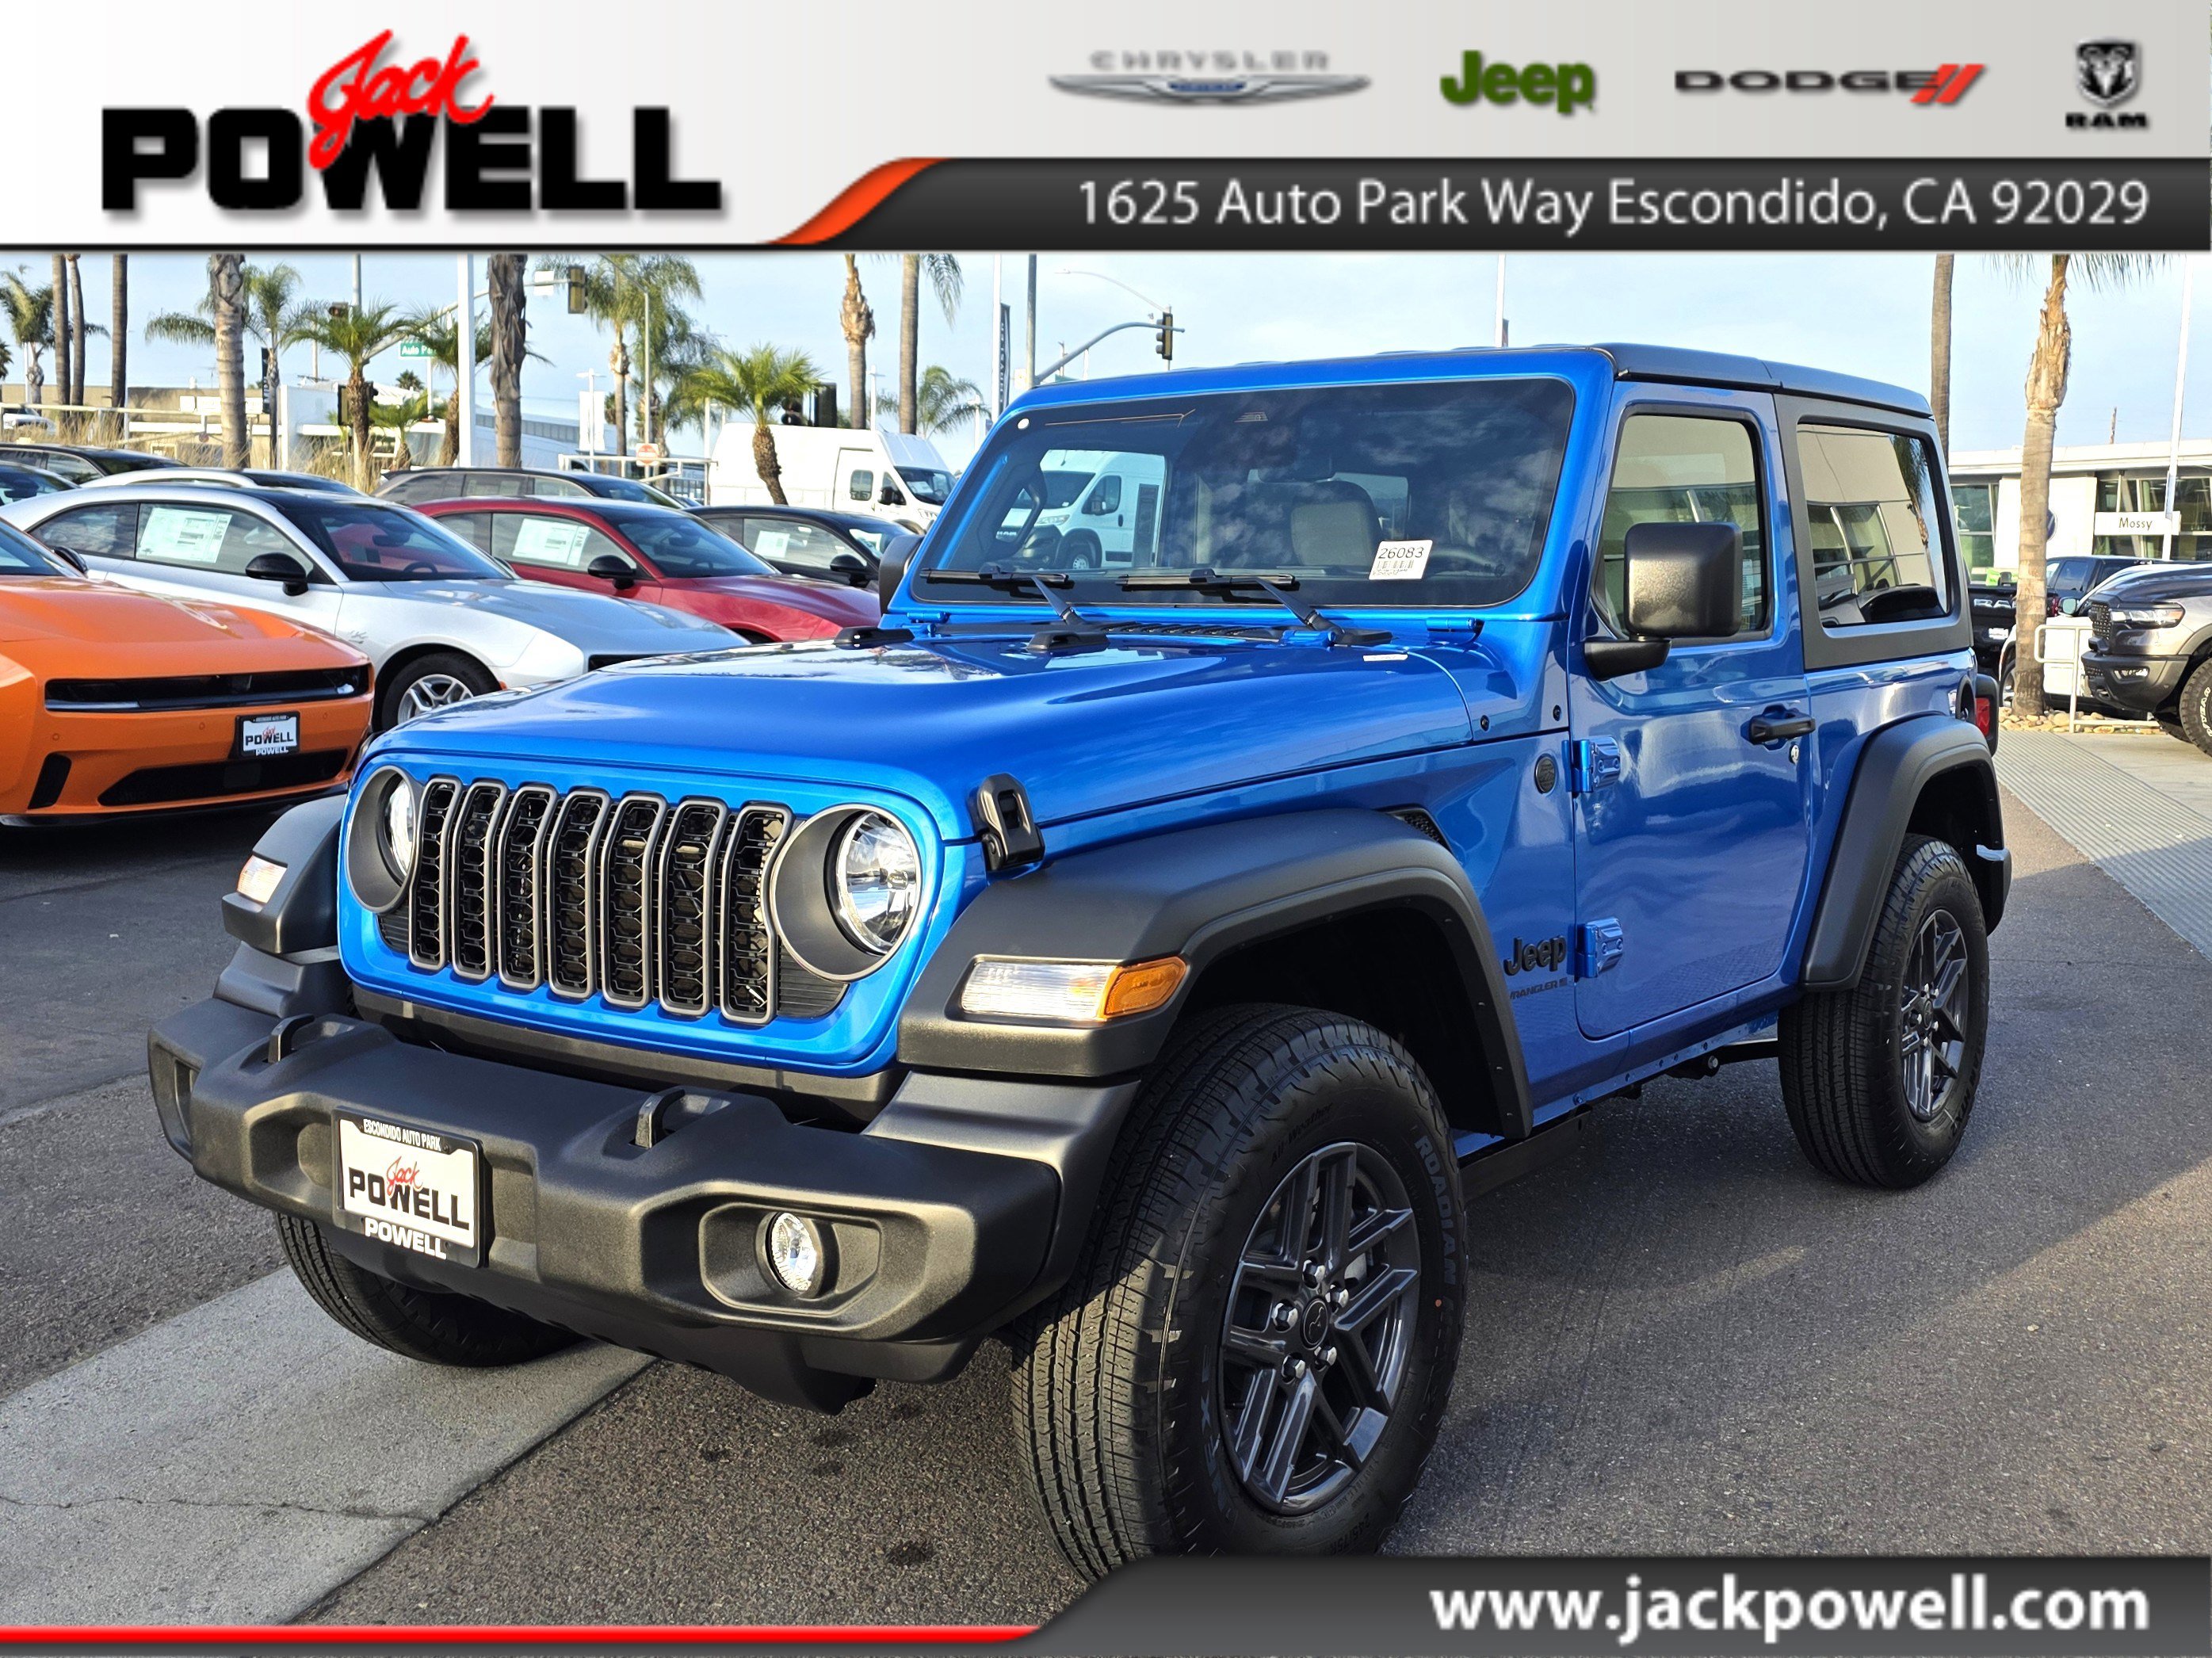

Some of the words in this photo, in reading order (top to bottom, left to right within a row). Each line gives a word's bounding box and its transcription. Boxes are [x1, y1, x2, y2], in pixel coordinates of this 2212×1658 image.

[402, 346, 420, 355] Auto
[2118, 518, 2153, 530] Mossy
[1378, 547, 1424, 559] 26083
[1973, 598, 2017, 609] RA
[245, 732, 294, 746] POWELL
[255, 746, 289, 756] POWELL
[1503, 935, 1566, 976] Jeep
[363, 1118, 401, 1142] ESCONDIDO
[402, 1129, 420, 1147] AUTO
[422, 1133, 441, 1152] PARK
[386, 1156, 423, 1196] Jack
[348, 1167, 469, 1231] POWELL
[1414, 1135, 1456, 1285] ROADIAN
[364, 1217, 447, 1260] POWELL
